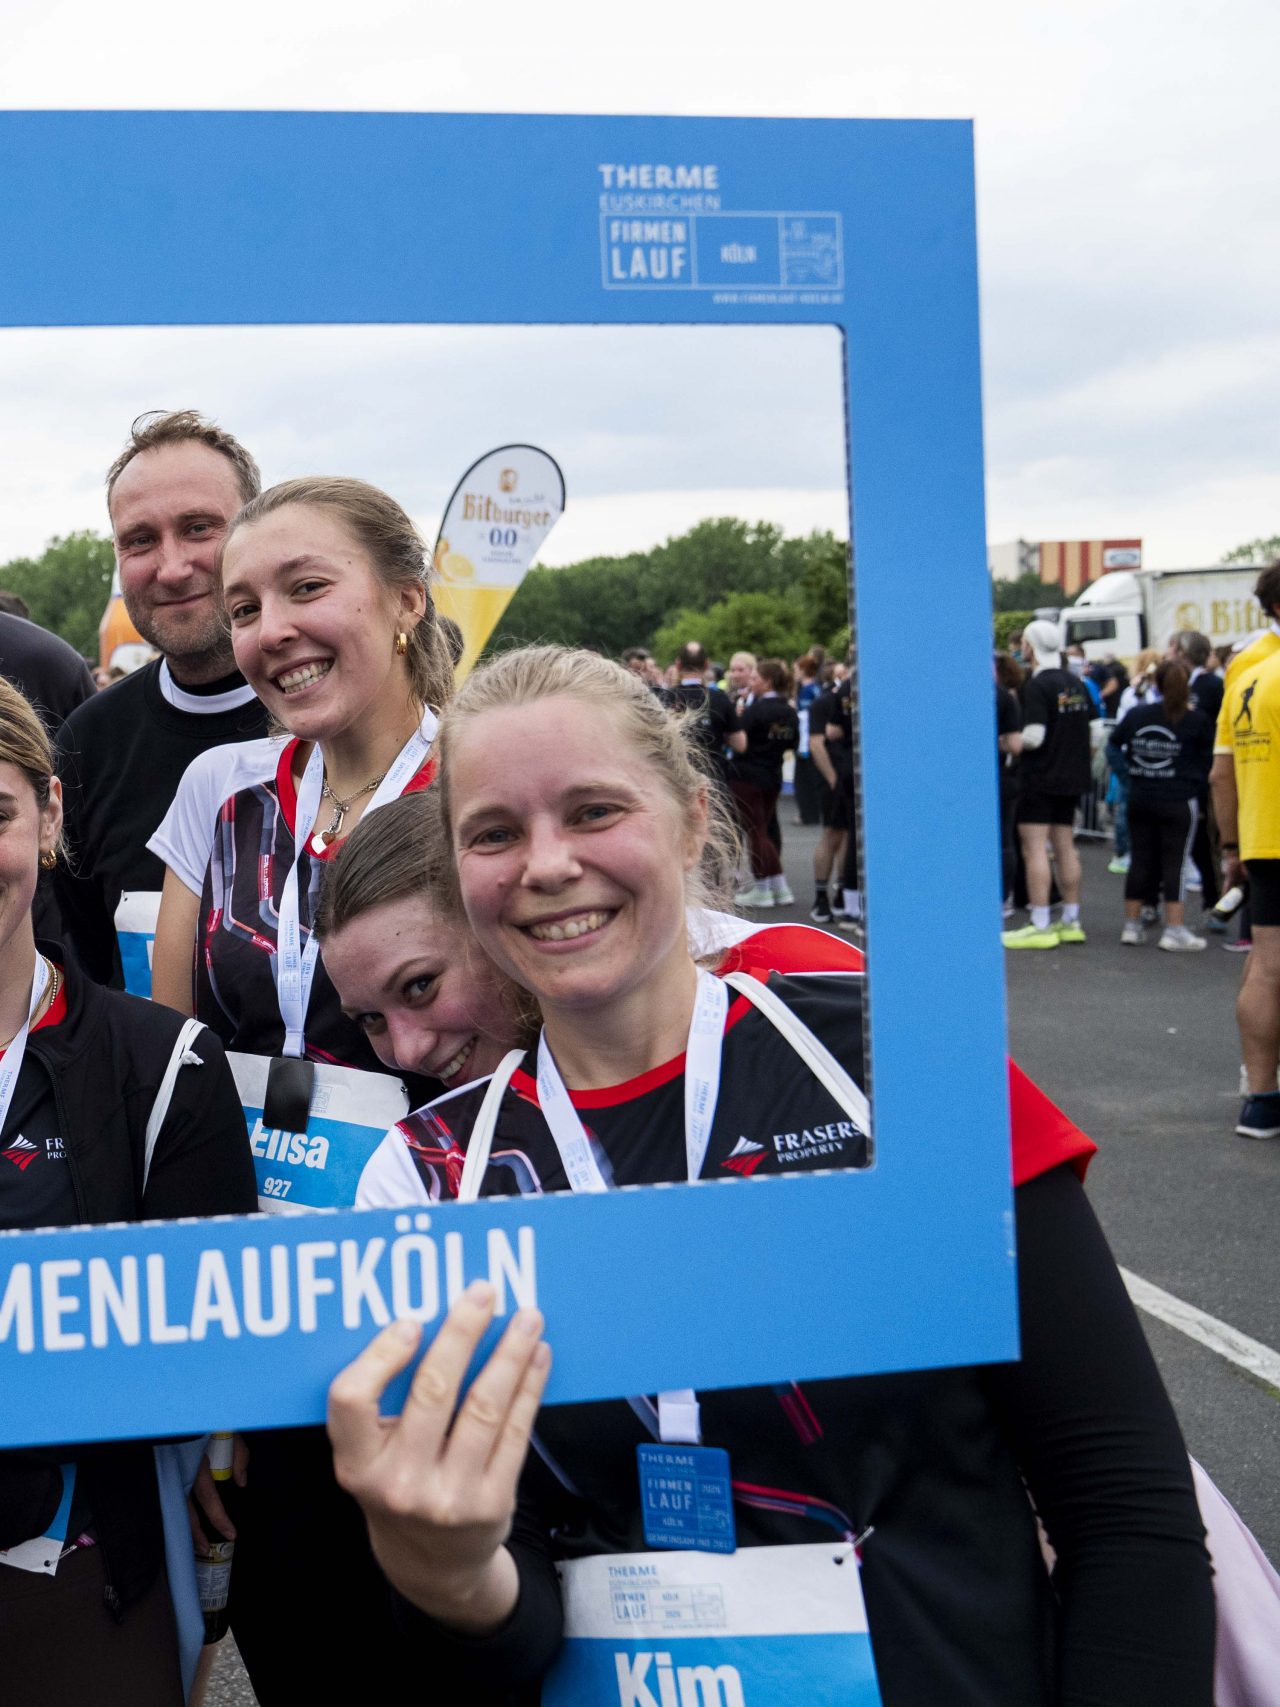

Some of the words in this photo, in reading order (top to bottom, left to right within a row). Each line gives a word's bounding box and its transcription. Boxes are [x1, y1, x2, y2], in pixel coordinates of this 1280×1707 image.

[598, 164, 719, 189] THERME
[599, 193, 720, 211] EUSKIRCHEN
[610, 220, 687, 243] FIRMEN
[611, 247, 687, 279] LAUF
[463, 492, 551, 529] Bitburger
[0, 1071, 13, 1098] THERME
[249, 1118, 330, 1169] Elisa
[777, 1141, 843, 1163] PROPERTY
[263, 1177, 292, 1198] 927
[640, 1453, 694, 1466] THERME
[647, 1478, 693, 1492] FIRMEN
[648, 1492, 692, 1511] LAUF
[608, 1566, 657, 1577] THERME
[614, 1591, 646, 1602] FIRMEN
[616, 1603, 648, 1619] LAUF
[614, 1652, 744, 1707] Kim
